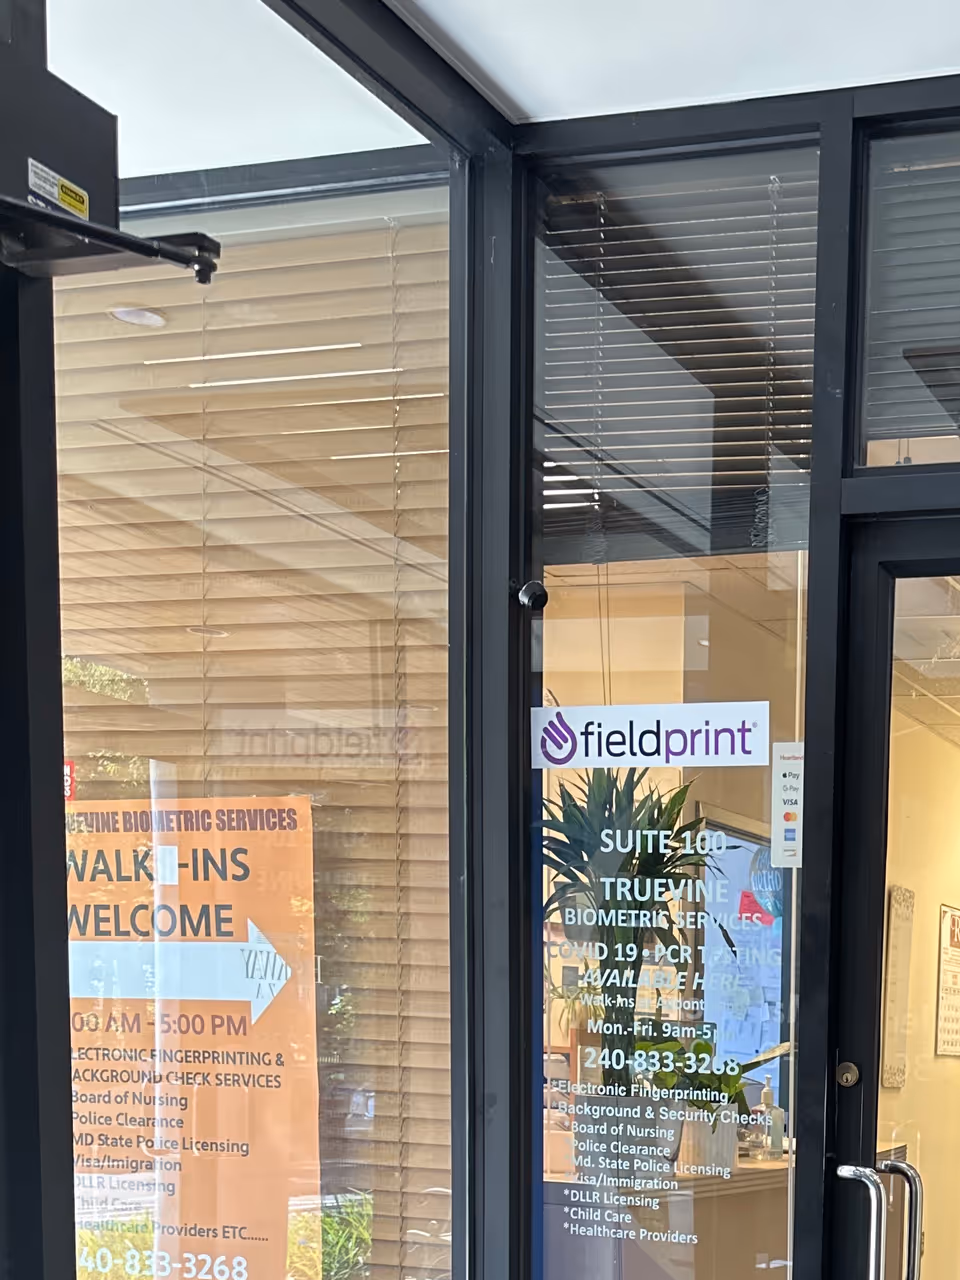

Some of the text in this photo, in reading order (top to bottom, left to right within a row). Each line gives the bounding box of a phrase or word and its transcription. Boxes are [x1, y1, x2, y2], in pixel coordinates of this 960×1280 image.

[580, 720, 752, 764] fieldprint
[788, 772, 800, 780] Pay
[122, 810, 212, 833] BIOMETRIC
[215, 808, 298, 832] SERVICES
[600, 828, 727, 855] SUITE 100
[600, 877, 729, 904] TRUEVINE
[67, 904, 234, 937] WELCOME
[564, 908, 763, 932] BIOMETRIC SERVICES
[547, 941, 608, 960] COVID
[614, 943, 638, 962] 19
[654, 944, 692, 963] PCR
[582, 968, 688, 990] AVAILABLE
[105, 1013, 141, 1034] AM
[160, 1014, 205, 1036] 5:00
[211, 1015, 247, 1036] PM
[150, 1048, 272, 1066] FINGERPRINTING
[275, 1052, 285, 1067] &
[165, 1071, 211, 1087] CHECK
[215, 1073, 282, 1089] SERVICES
[71, 1091, 188, 1111] Board of Nursing
[630, 1083, 729, 1106] Fingerprinting
[71, 1110, 184, 1129] Police Clearance
[645, 1106, 655, 1119] &
[659, 1107, 717, 1127] Security
[720, 1110, 773, 1127] Checks
[610, 1122, 624, 1136] of
[627, 1124, 675, 1141] Nursing
[73, 1133, 94, 1147] MD
[97, 1134, 133, 1149] State
[182, 1138, 249, 1157] Licensing
[610, 1141, 671, 1157] Clearance
[598, 1157, 630, 1171] State
[633, 1159, 670, 1173] Police
[673, 1162, 731, 1179] Licensing
[109, 1176, 176, 1196] Licensing
[603, 1192, 660, 1210] Licensing
[604, 1210, 632, 1223] Care
[152, 1221, 218, 1239] Providers
[639, 1229, 698, 1244] Providers
